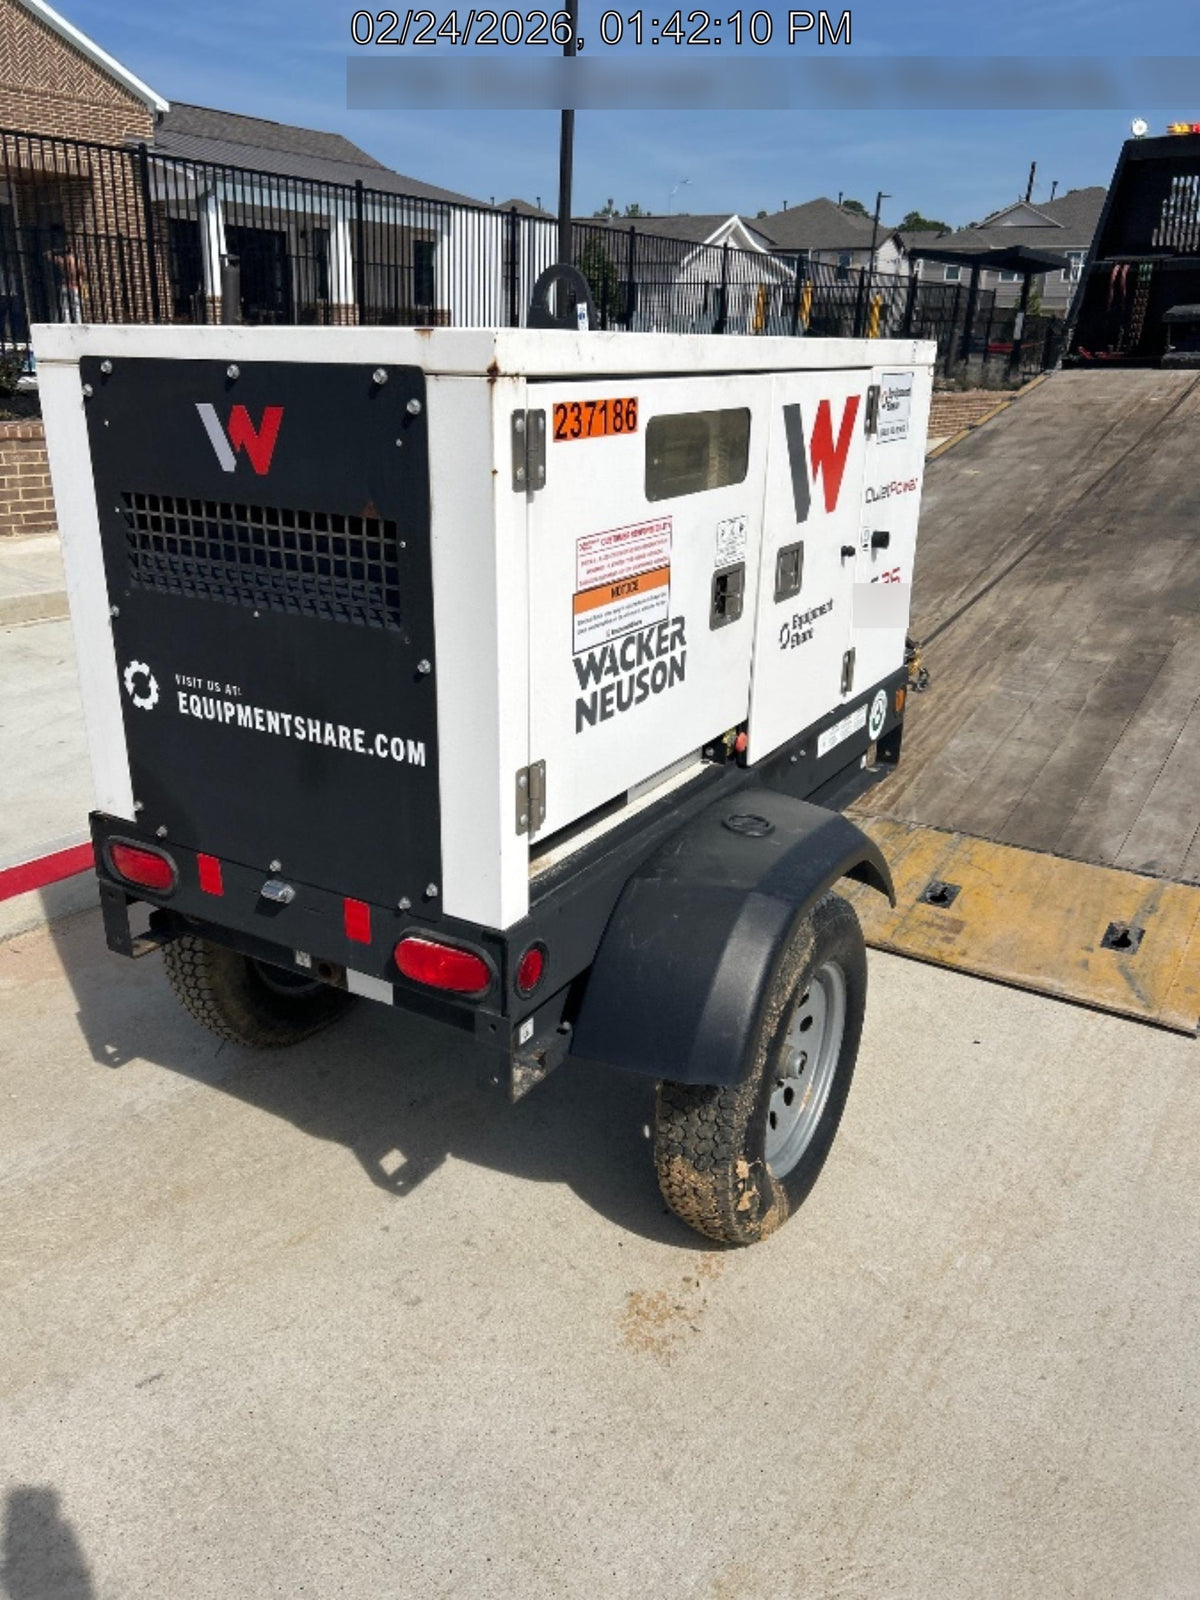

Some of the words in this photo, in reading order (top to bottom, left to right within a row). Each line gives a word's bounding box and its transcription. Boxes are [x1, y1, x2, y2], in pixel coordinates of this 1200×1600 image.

[554, 398, 638, 440] 237186
[175, 673, 203, 690] VISIT
[207, 679, 221, 693] US
[572, 615, 687, 691] WACKER
[178, 691, 427, 768] EQUIPMENTSHARE.COM
[576, 651, 686, 734] NEUSON
